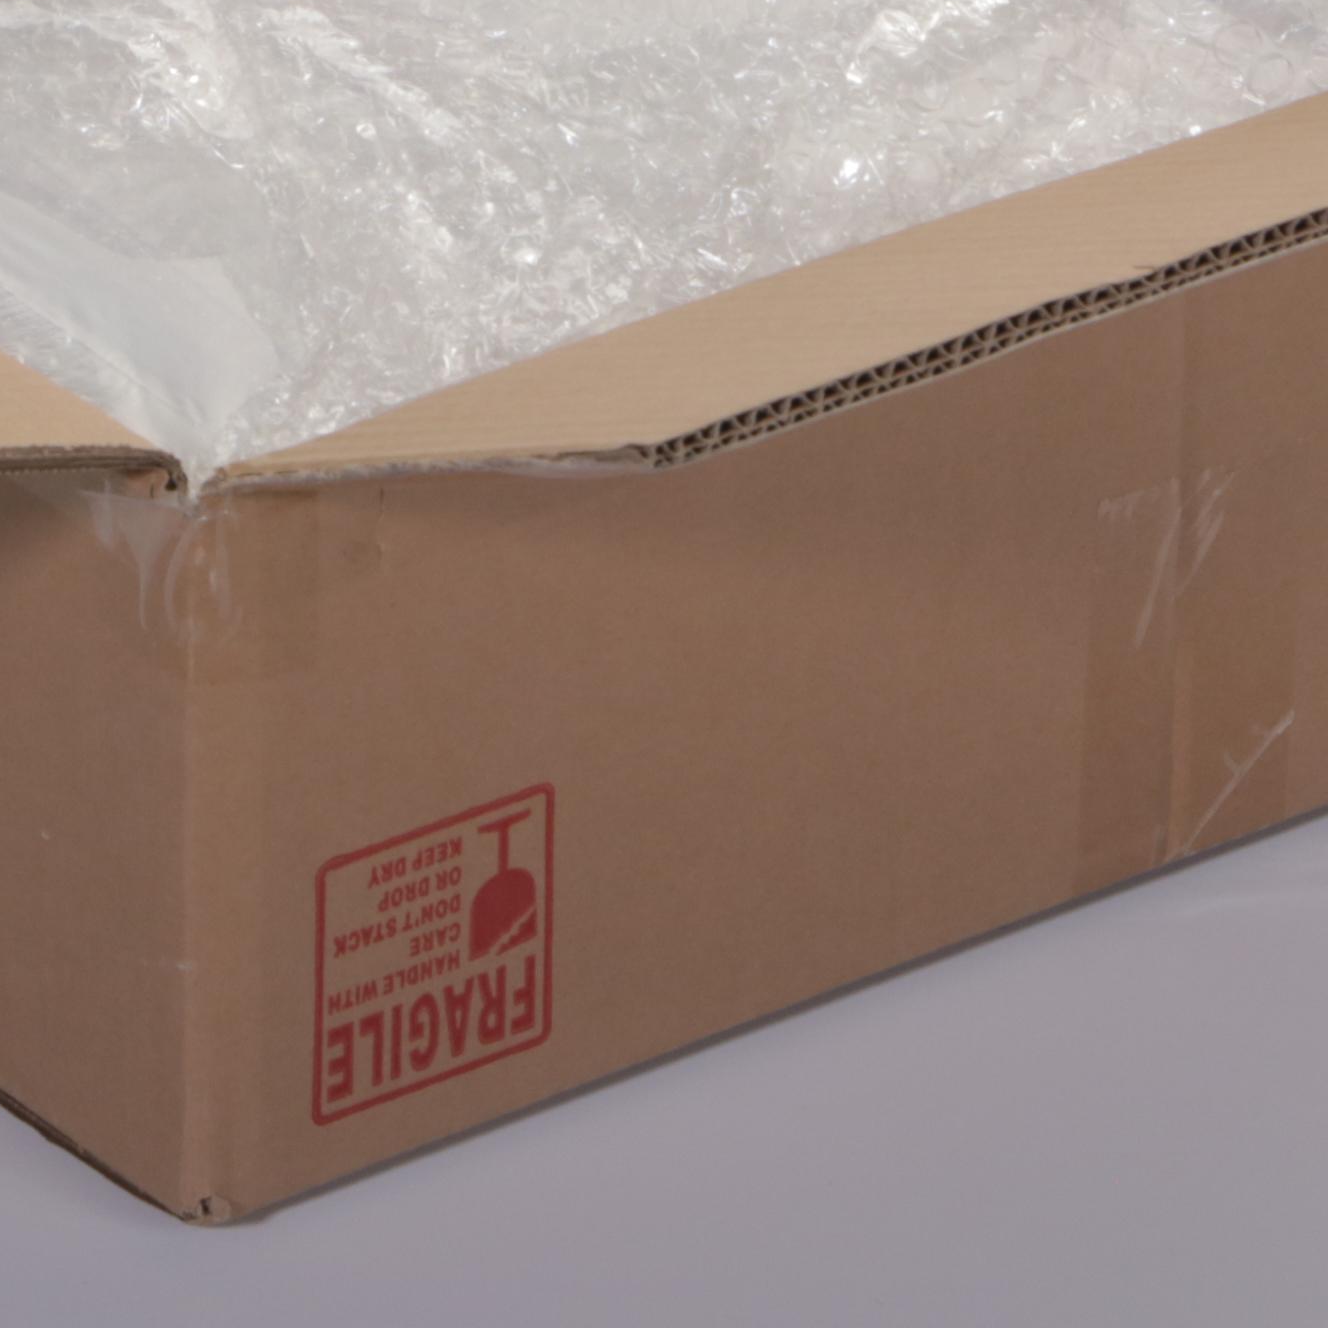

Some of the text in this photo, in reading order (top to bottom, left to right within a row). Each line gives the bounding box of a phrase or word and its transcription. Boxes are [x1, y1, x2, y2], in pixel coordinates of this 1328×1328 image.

[367, 837, 463, 890] KEEP DRY
[378, 866, 462, 913] OR DROP
[333, 894, 462, 959] DON'T STACK
[409, 922, 461, 957] CARE
[328, 949, 461, 1016] HANDLE WITH
[327, 954, 537, 1103] FRAGILE
